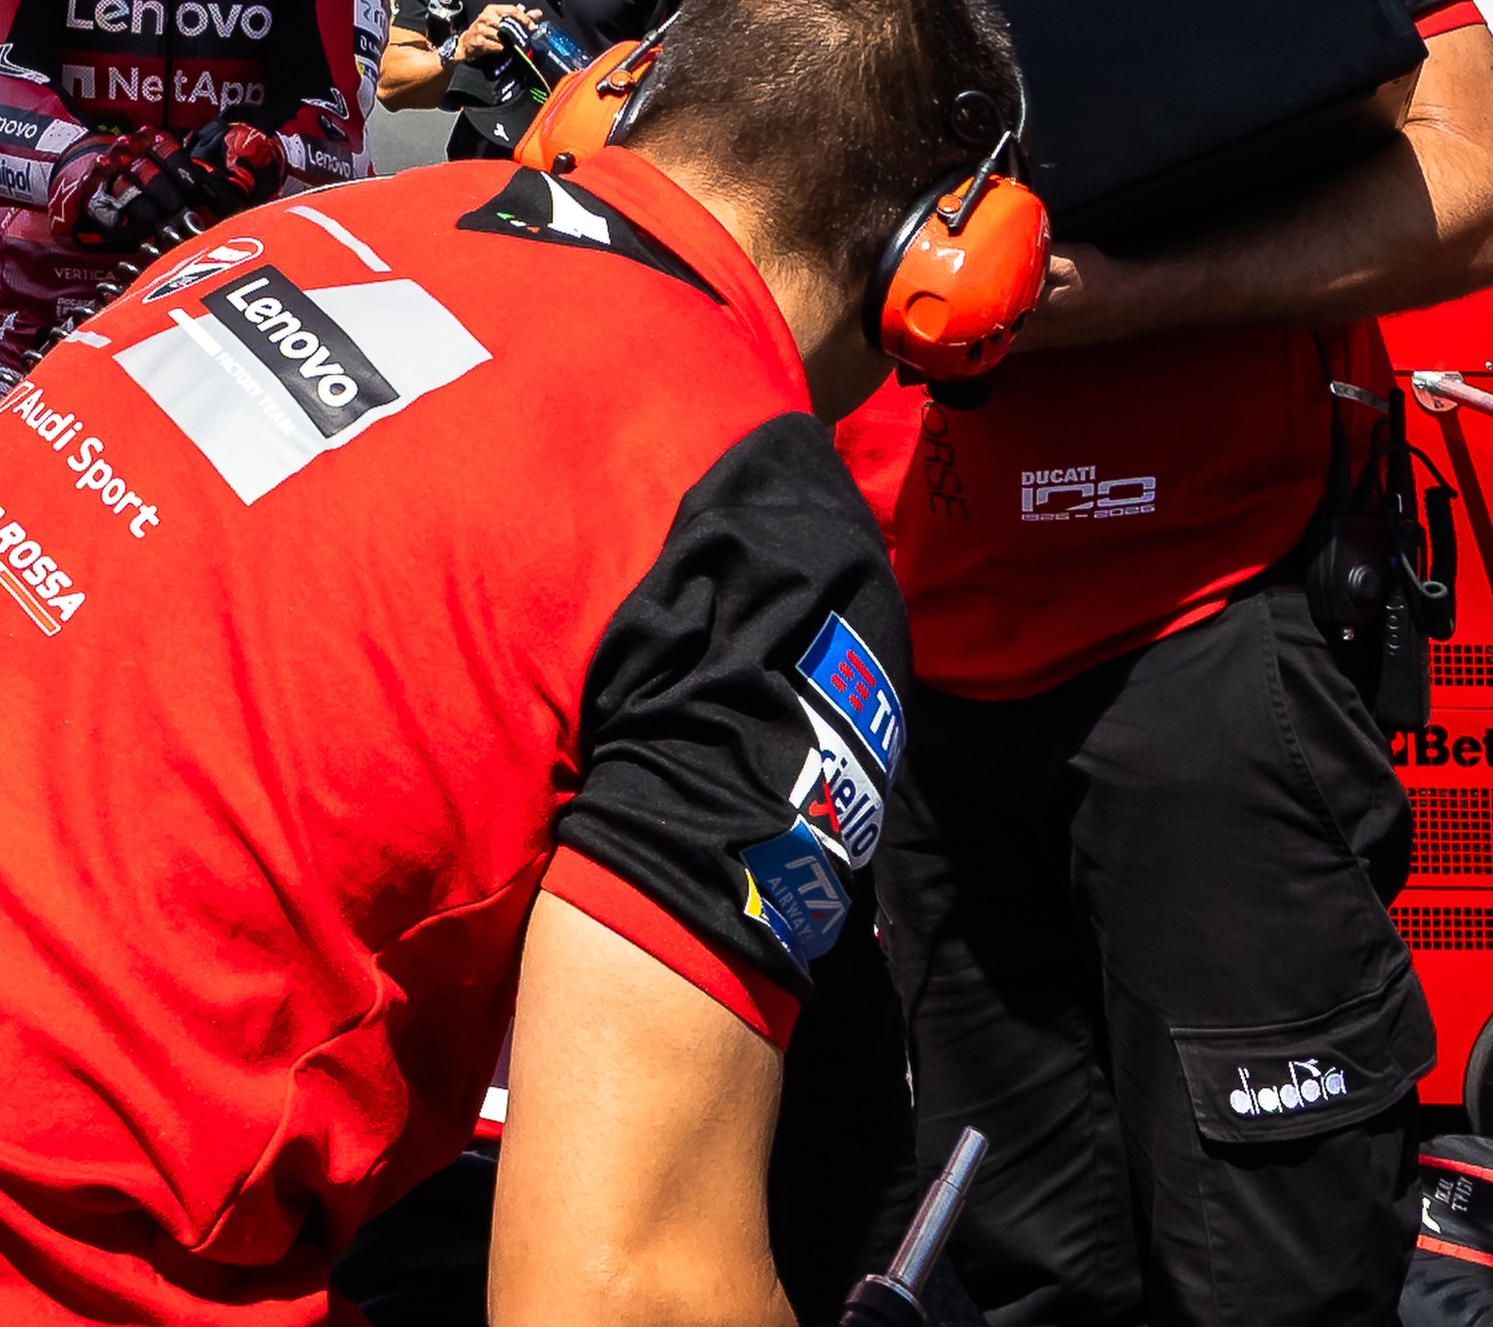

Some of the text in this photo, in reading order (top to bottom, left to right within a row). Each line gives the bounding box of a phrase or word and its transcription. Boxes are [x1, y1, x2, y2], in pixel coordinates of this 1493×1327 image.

[109, 66, 266, 110] NetApp
[308, 144, 352, 177] Lenovo
[55, 267, 118, 282] VERTICA
[226, 278, 358, 408] Lenovo
[215, 349, 296, 437] FACTORY TEAM
[12, 388, 161, 539] Audi Sport
[922, 402, 971, 522] ORSE
[1022, 466, 1096, 485] DUCATI
[785, 855, 846, 936] ITA
[1230, 1059, 1347, 1116] diadora
